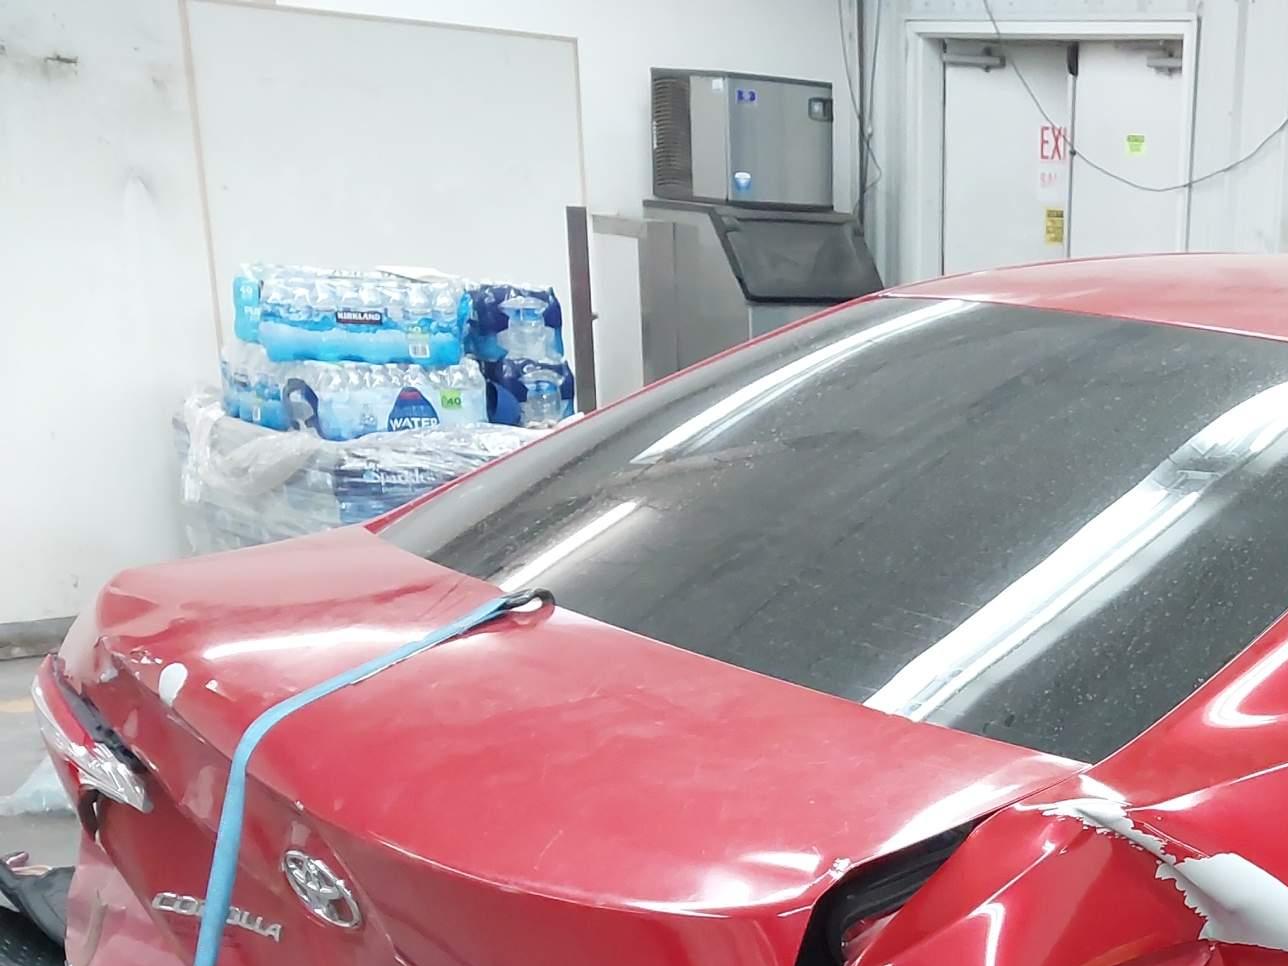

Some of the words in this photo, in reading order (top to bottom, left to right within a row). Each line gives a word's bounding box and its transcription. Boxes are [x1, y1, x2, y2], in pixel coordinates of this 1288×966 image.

[336, 311, 382, 321] KIRKLAND
[389, 416, 438, 432] WATER
[151, 892, 283, 942] COOLLA
